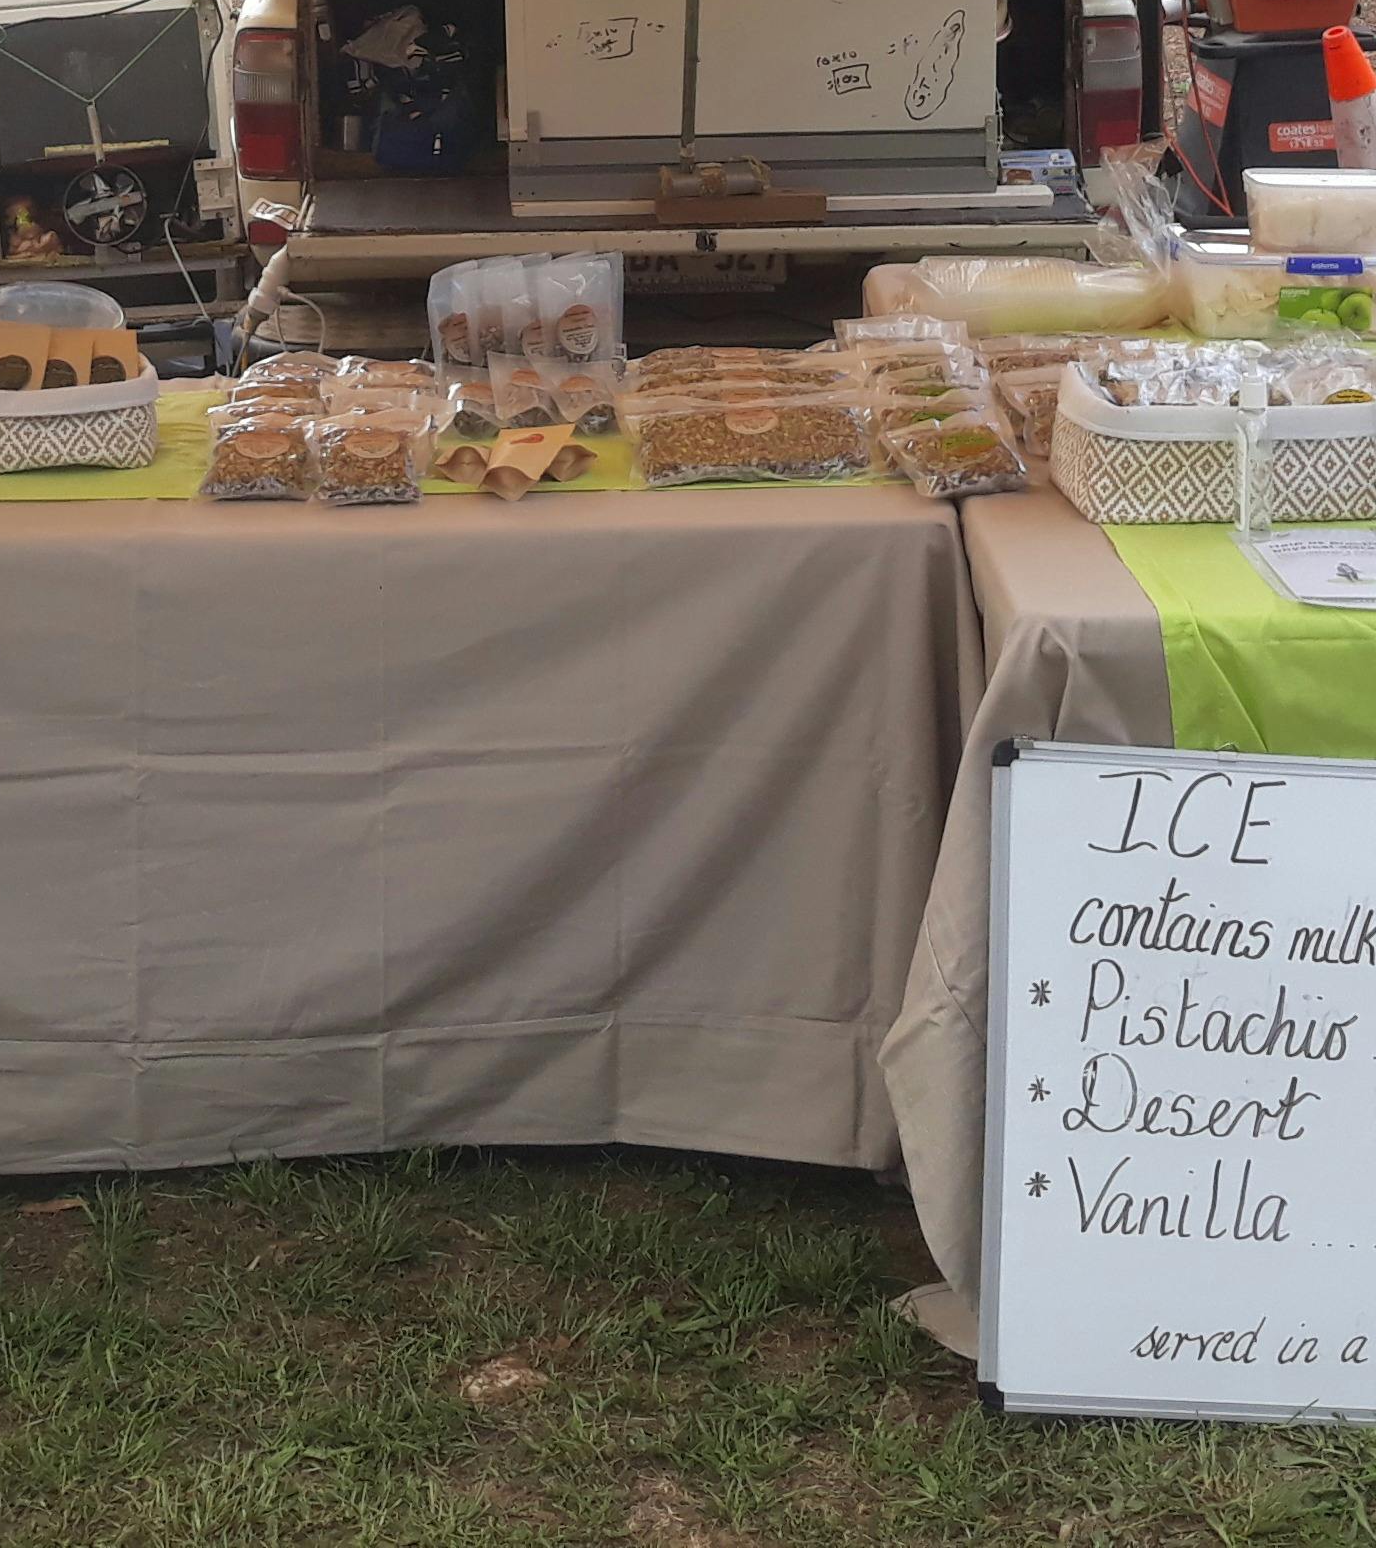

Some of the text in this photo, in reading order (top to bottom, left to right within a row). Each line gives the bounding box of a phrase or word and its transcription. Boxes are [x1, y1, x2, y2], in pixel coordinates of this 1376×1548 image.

[1087, 770, 1288, 866] ICE
[1068, 877, 1271, 958] contains
[1077, 958, 1359, 1061] Pistachio
[1060, 1051, 1323, 1142] Desert
[1067, 1155, 1291, 1245] Vanilla
[1130, 1313, 1261, 1366] served
[1276, 1323, 1319, 1366] in
[1339, 1331, 1368, 1366] a
